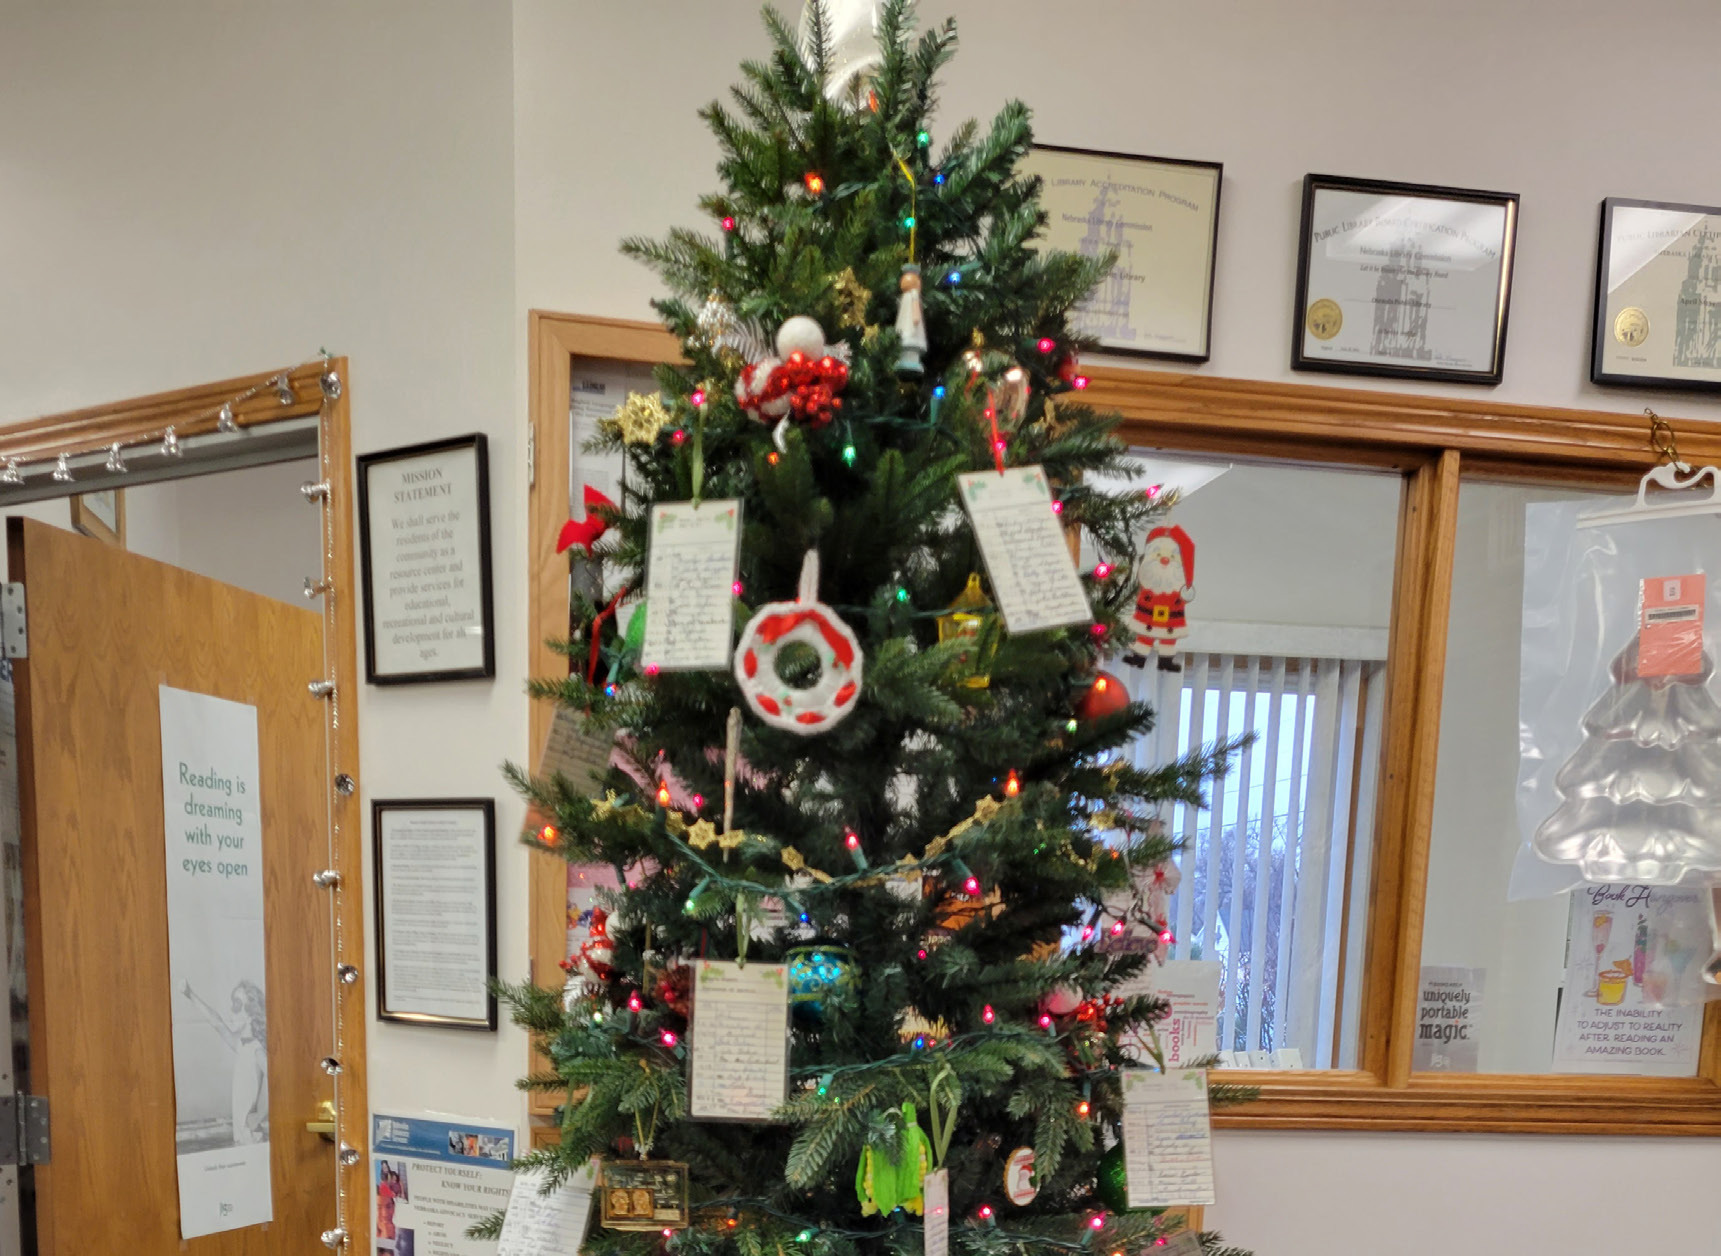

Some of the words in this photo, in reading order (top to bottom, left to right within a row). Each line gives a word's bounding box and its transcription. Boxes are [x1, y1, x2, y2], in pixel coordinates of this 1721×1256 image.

[1051, 178, 1085, 188] LIBRARY
[1090, 179, 1155, 198] ACCREDITATION
[1158, 190, 1199, 212] PROGRAM
[1313, 225, 1340, 244] PUBLIC
[1119, 272, 1146, 284] Library
[402, 467, 442, 484] MISSION
[394, 483, 452, 504] STATEMENT
[392, 519, 404, 529] We
[406, 514, 424, 528] shall
[426, 514, 446, 525] serve
[448, 510, 460, 521] the
[442, 528, 454, 540] the
[396, 548, 437, 562] community
[390, 568, 421, 580] resource
[423, 564, 447, 576] center
[448, 559, 463, 572] and
[389, 582, 418, 600] provide
[420, 581, 452, 592] services
[453, 576, 464, 589] for
[382, 614, 427, 630] recreational
[429, 612, 443, 625] and
[444, 608, 474, 623] cultural
[392, 632, 440, 646] development
[442, 627, 454, 640] for
[179, 761, 232, 797] Reading
[236, 776, 246, 794] is
[184, 792, 243, 826] dreaming
[185, 823, 212, 846] with
[216, 834, 244, 852] your
[182, 858, 212, 877] eyes
[217, 862, 248, 878] open
[1587, 884, 1626, 906] Book
[1423, 988, 1471, 1006] uniquely
[1420, 1004, 1469, 1022] portable
[1594, 1008, 1614, 1018] THE
[1616, 1009, 1664, 1018] INABILITY
[1577, 1020, 1589, 1030] TO
[1590, 1021, 1626, 1032] ADJUST
[1628, 1022, 1641, 1031] TO
[1642, 1022, 1682, 1032] REALITY
[1168, 1018, 1181, 1063] books
[1578, 1033, 1610, 1042] AFTER
[1614, 1034, 1658, 1042] READING
[1584, 1046, 1632, 1056] AMAZING
[1634, 1046, 1666, 1056] BOOK.
[412, 1162, 442, 1175] PROTECT
[444, 1166, 482, 1180] YOURSELF:
[441, 1180, 462, 1190] KNOW
[463, 1183, 482, 1194] YOUR
